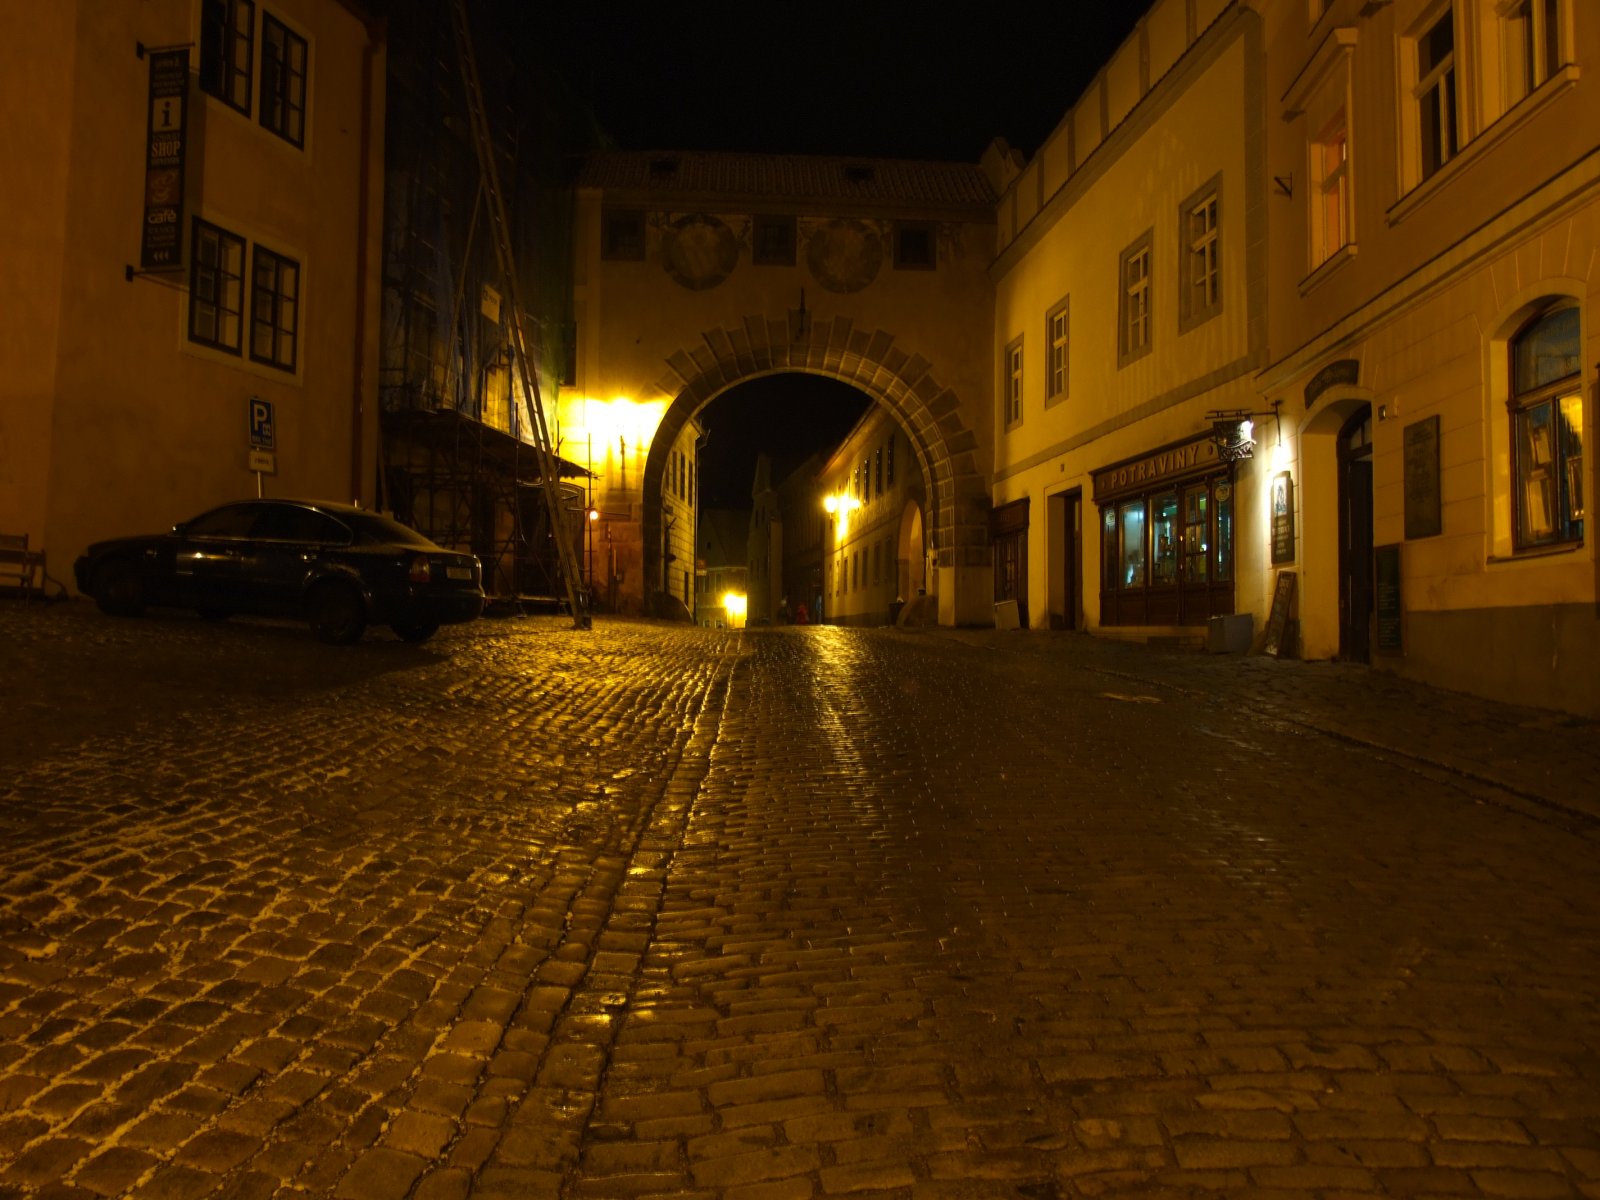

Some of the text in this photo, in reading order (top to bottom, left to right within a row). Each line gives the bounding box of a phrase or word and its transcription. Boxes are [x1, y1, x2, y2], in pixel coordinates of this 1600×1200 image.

[162, 101, 172, 127] i
[152, 141, 181, 157] SHOP
[253, 404, 268, 432] P
[1111, 446, 1200, 489] POTRAVINY
